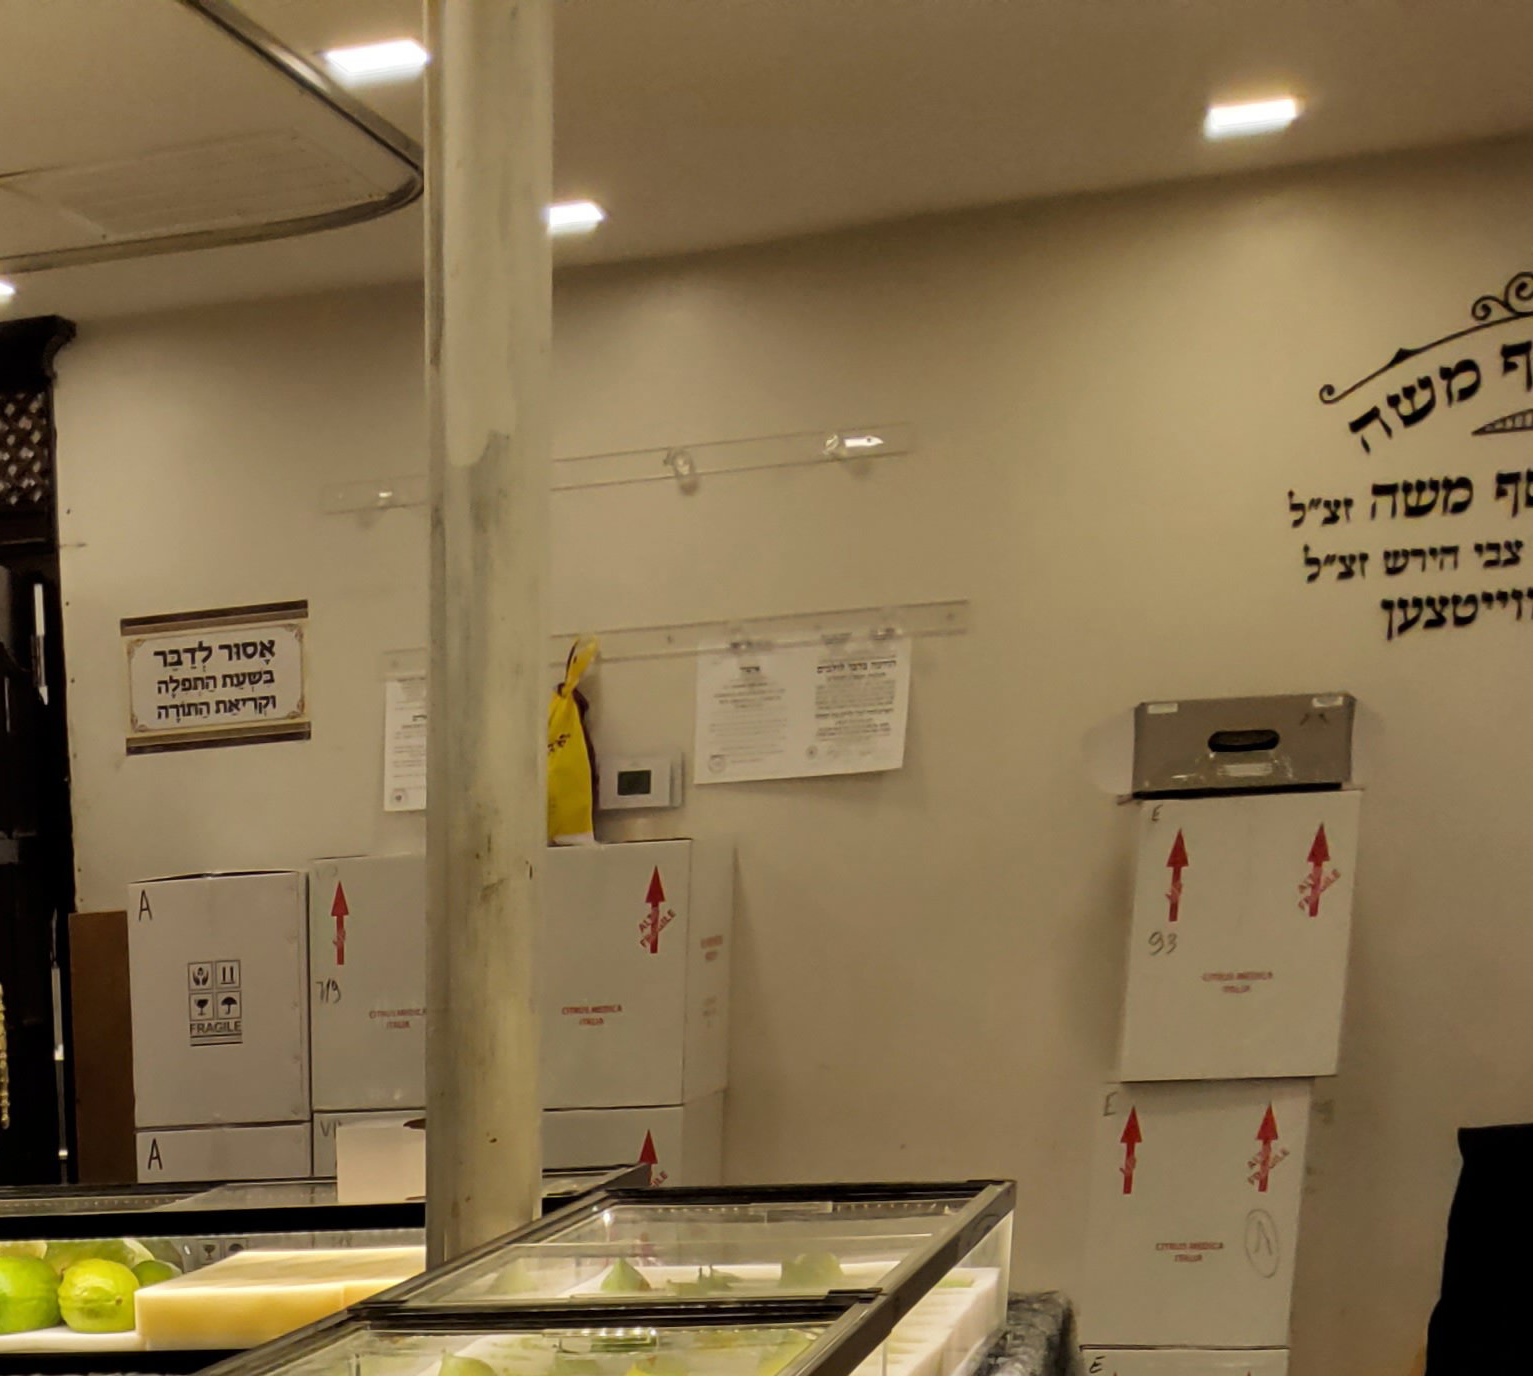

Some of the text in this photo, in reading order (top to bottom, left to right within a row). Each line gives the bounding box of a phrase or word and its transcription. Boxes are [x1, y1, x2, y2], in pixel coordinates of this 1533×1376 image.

[1348, 358, 1482, 454] משה
[1370, 476, 1474, 521] משה
[1384, 545, 1460, 576] הירש
[1474, 539, 1524, 568] צבי
[138, 889, 153, 922] A
[1298, 868, 1342, 911] FRILE
[639, 909, 676, 948] FRILE
[189, 1021, 243, 1035] FRAGILE
[147, 1138, 163, 1170] A
